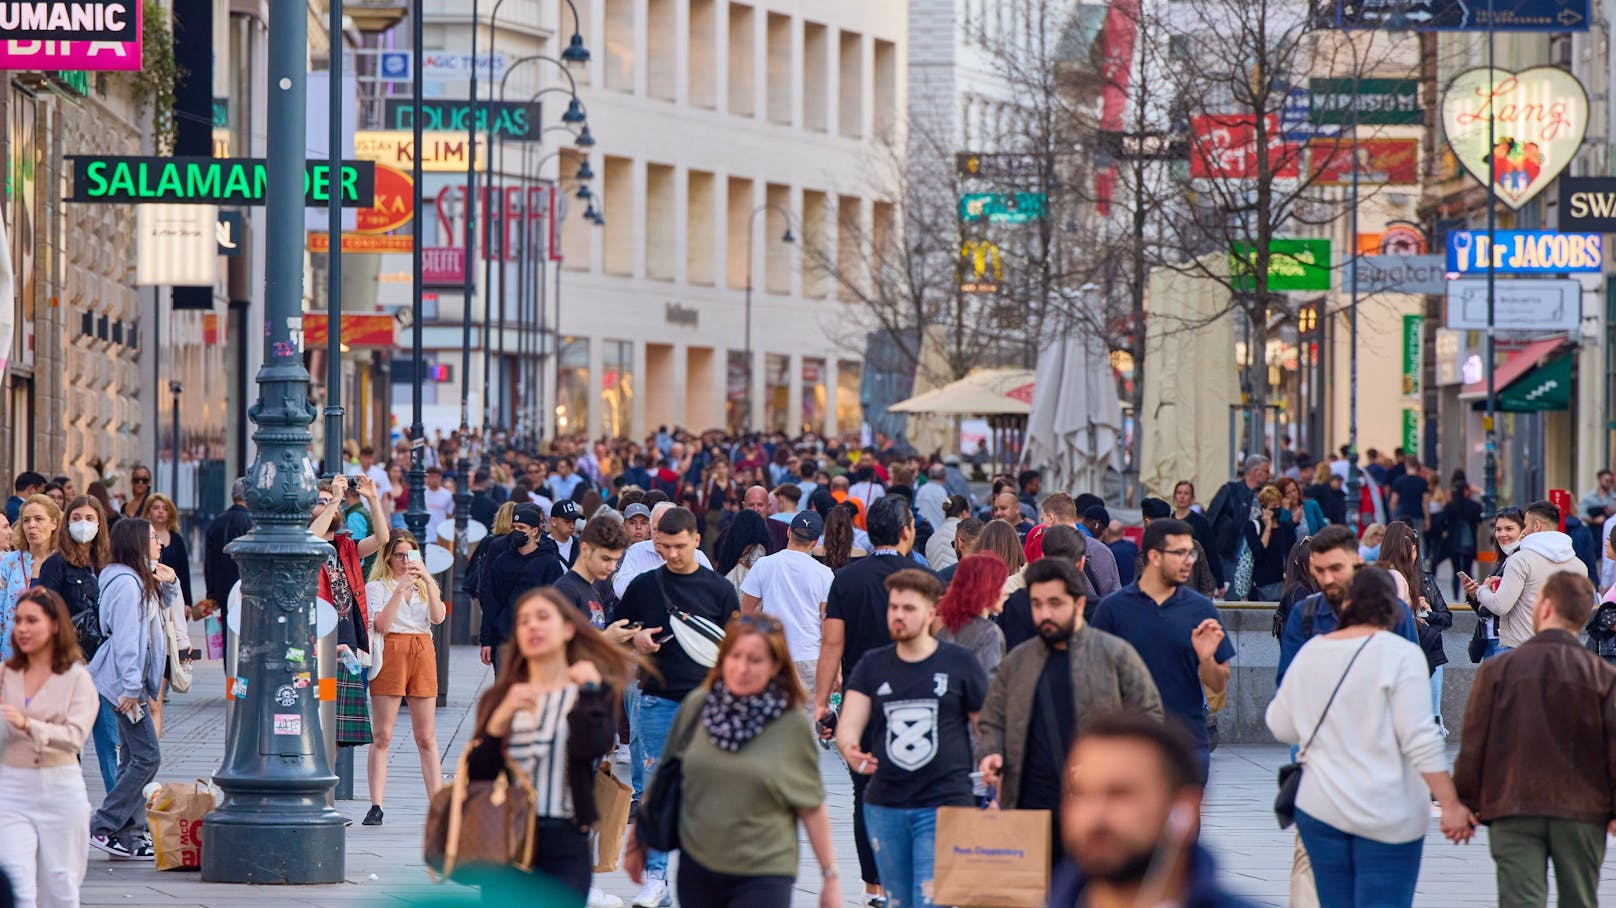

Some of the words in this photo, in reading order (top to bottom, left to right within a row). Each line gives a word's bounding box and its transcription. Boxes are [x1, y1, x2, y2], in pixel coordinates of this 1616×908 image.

[1475, 235, 1508, 268] Dr
[1509, 234, 1602, 269] JACOBS
[1356, 262, 1445, 284] swatch
